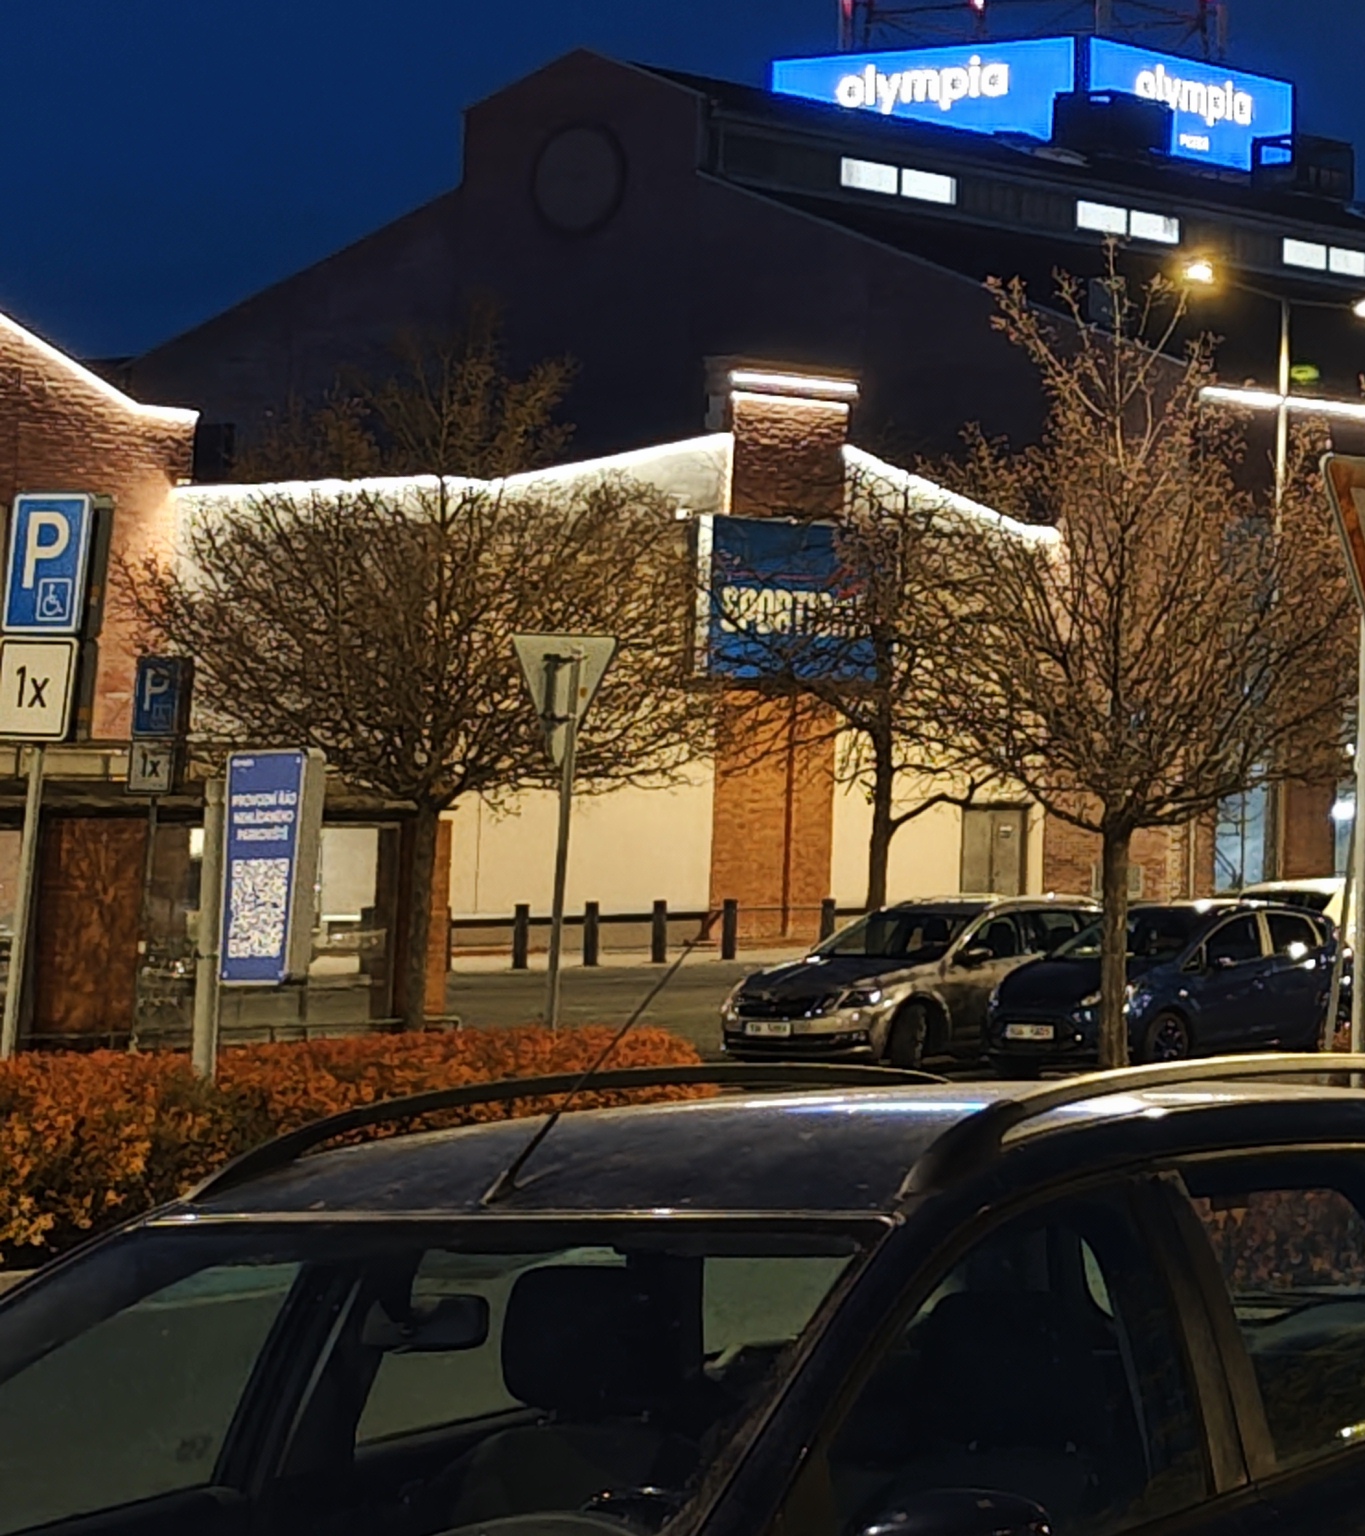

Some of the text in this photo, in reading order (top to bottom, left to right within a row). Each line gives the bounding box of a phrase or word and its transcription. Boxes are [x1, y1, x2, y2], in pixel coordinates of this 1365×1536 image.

[834, 54, 1010, 115] olympia
[1134, 63, 1253, 128] olympia
[21, 511, 70, 590] P
[16, 665, 50, 708] 1x
